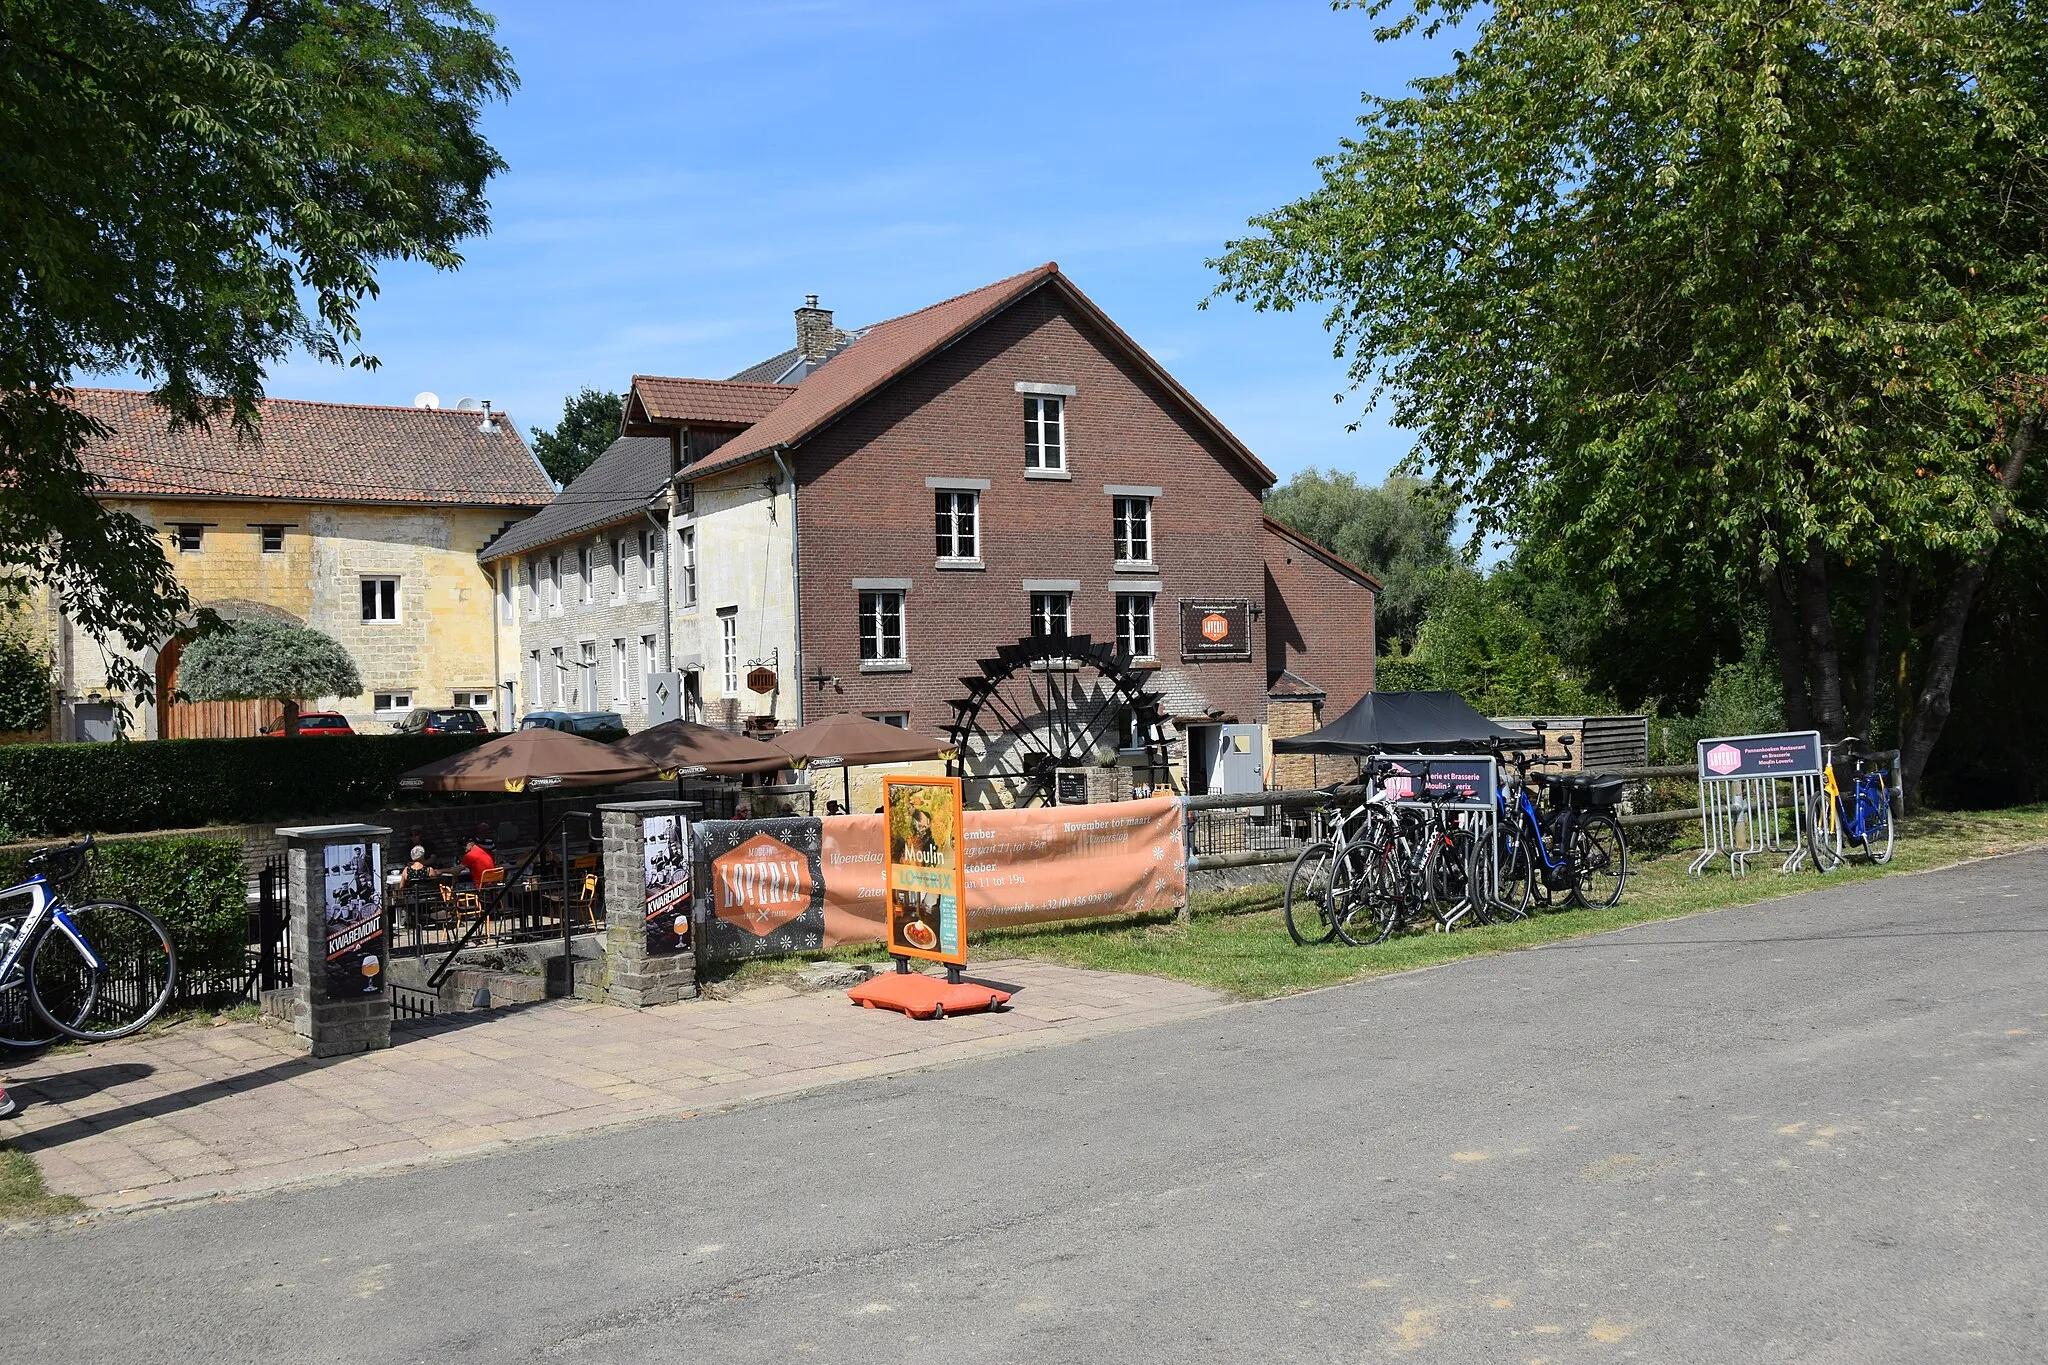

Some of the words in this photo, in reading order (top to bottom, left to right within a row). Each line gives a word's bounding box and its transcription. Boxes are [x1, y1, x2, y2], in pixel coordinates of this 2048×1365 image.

[1451, 772, 1480, 780] Brasserie
[1425, 782, 1448, 790] Moulin
[1064, 820, 1109, 833] November
[1111, 818, 1124, 828] tot
[1126, 815, 1152, 826] maart
[963, 829, 996, 840] ember
[1087, 832, 1129, 844] Winterstop
[748, 847, 774, 857] MOULIN
[830, 851, 884, 865] Woensdag
[963, 846, 977, 858] ag
[978, 845, 996, 855] van
[997, 842, 1010, 852] 11
[1013, 842, 1026, 852] tot
[904, 842, 945, 865] Moulin
[963, 862, 997, 874] ktober
[721, 861, 801, 908] LOVERIX
[857, 886, 887, 898] Zater
[963, 881, 977, 889] an
[979, 877, 990, 888] 11
[993, 877, 1006, 886] tot
[1009, 874, 1026, 884] 19u
[899, 869, 953, 891] LOVERIX
[648, 880, 689, 915] KWAREMONT
[1041, 899, 1057, 910] +32
[1058, 897, 1071, 909] (0)
[1088, 893, 1102, 905] 928
[329, 916, 381, 954] KWAREMONT
